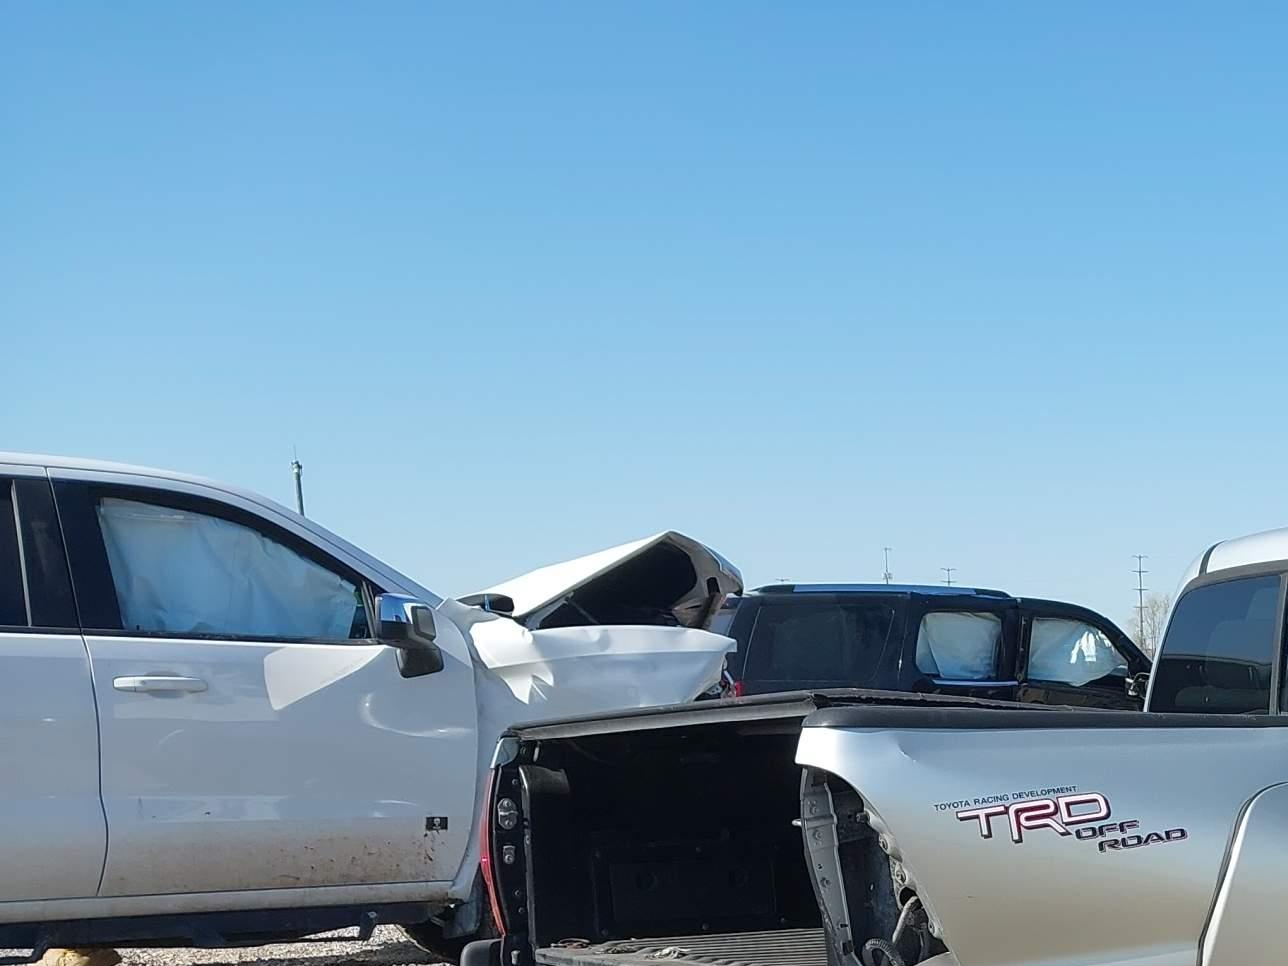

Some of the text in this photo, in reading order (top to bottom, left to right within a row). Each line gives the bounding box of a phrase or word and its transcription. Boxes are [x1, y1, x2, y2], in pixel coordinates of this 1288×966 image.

[933, 785, 1078, 812] TOYOTA RACING DEVELOPMENT
[956, 791, 1112, 844] TRD
[1074, 820, 1140, 840] OFF
[1098, 828, 1188, 853] ROAD
